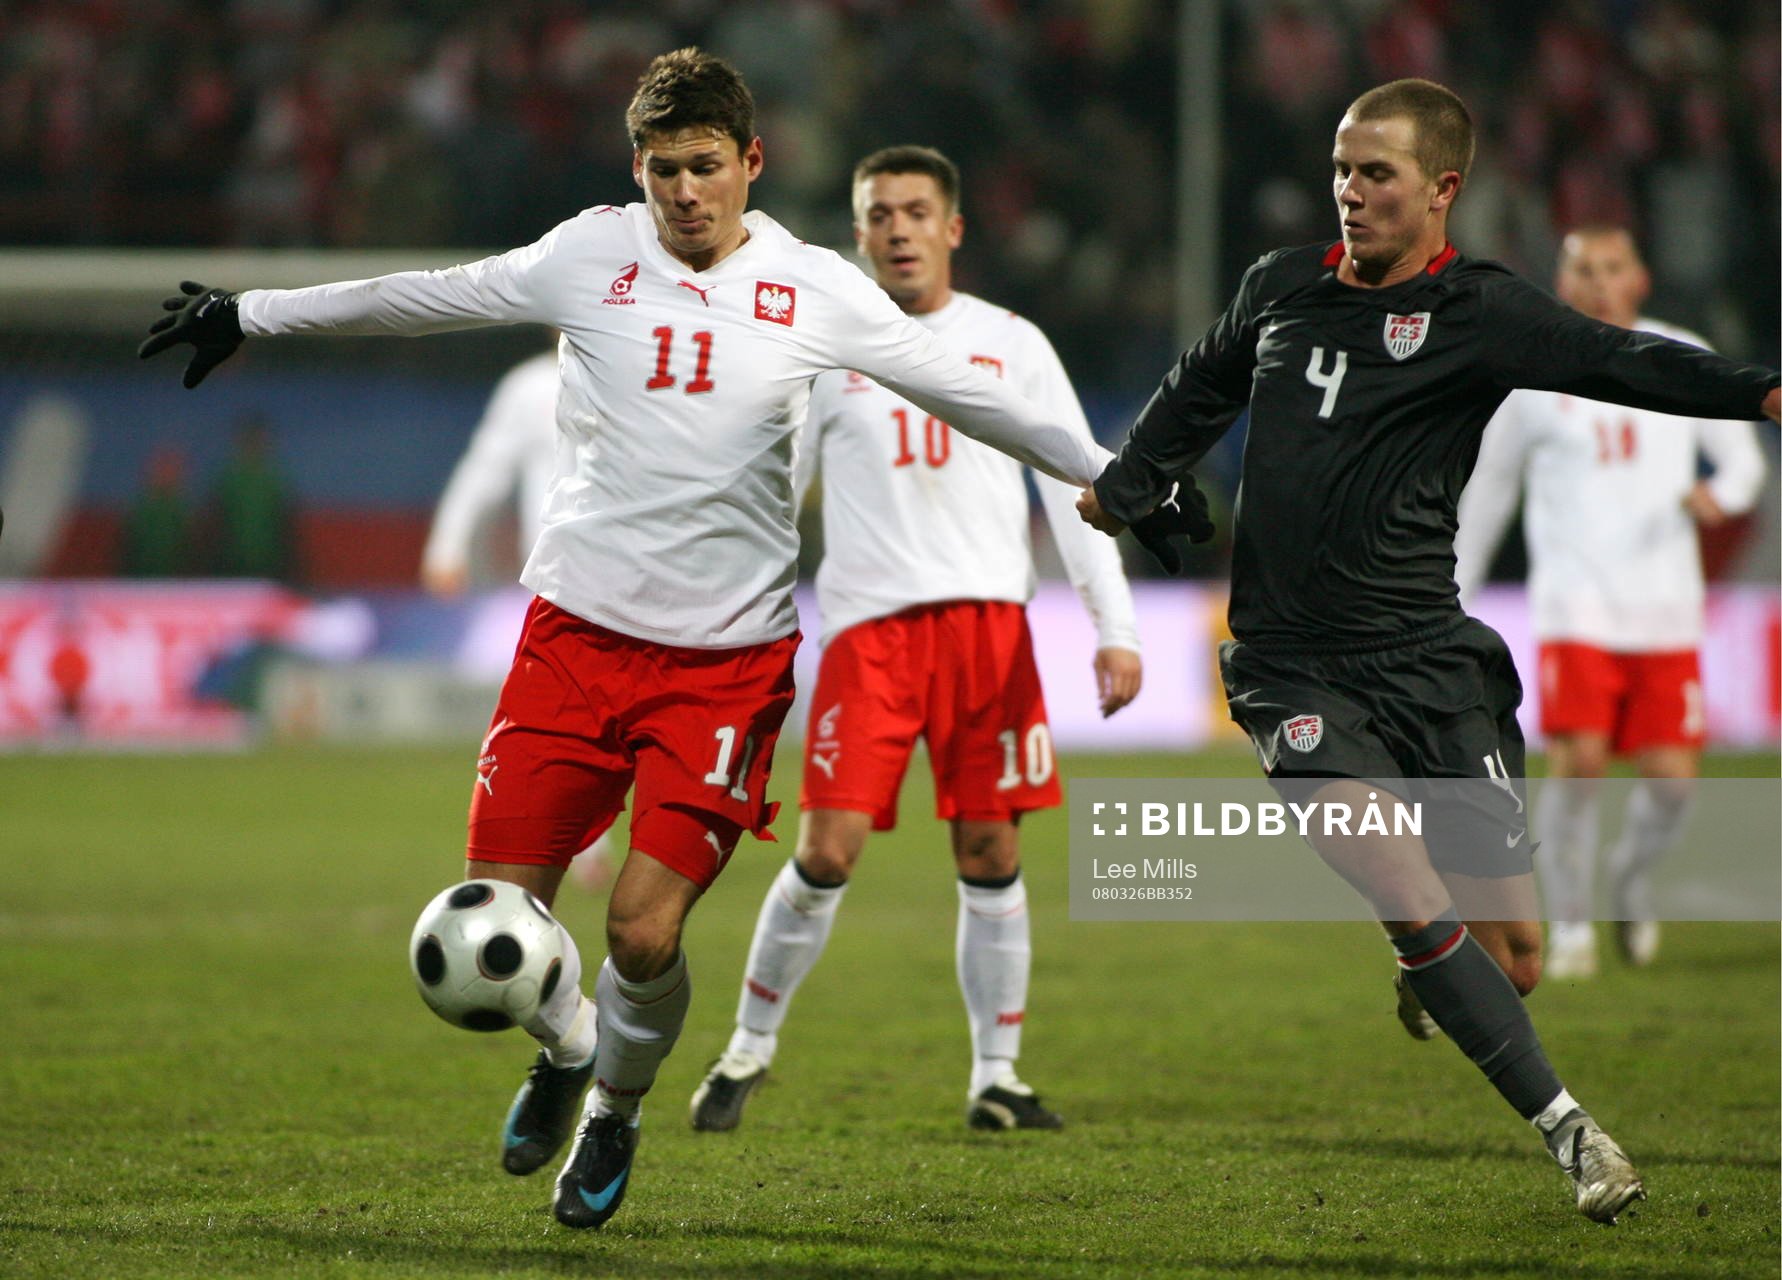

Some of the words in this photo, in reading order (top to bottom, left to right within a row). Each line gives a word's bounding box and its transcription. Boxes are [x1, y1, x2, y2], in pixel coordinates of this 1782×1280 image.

[601, 297, 636, 305] POLSKA
[645, 325, 715, 394] 11
[1305, 346, 1348, 419] 4
[891, 408, 952, 468] 10
[703, 725, 749, 802] 11
[996, 722, 1053, 790] 10
